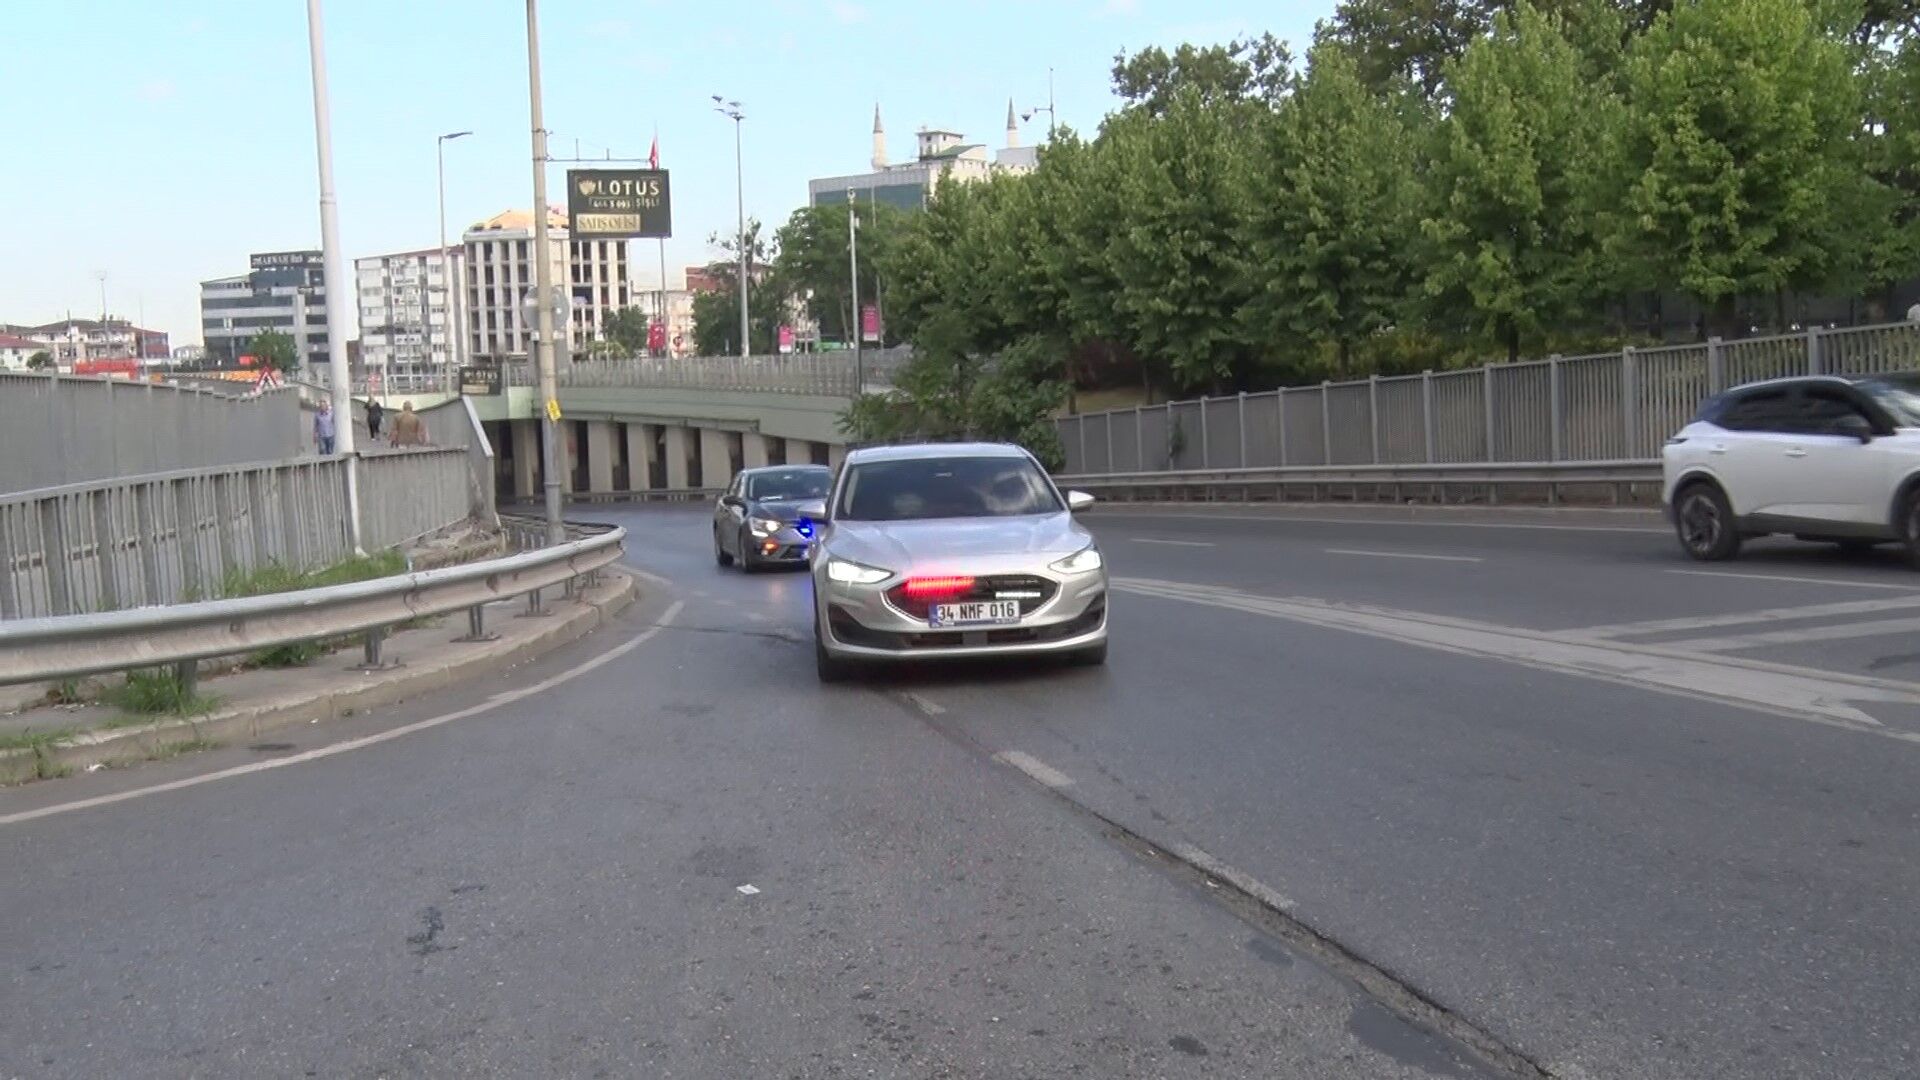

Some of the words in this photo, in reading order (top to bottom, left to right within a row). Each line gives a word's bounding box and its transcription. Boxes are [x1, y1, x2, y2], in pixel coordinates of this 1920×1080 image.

[598, 180, 660, 196] LOTUS
[938, 606, 954, 621] 34
[960, 604, 984, 619] NMF
[990, 602, 1015, 617] 016
